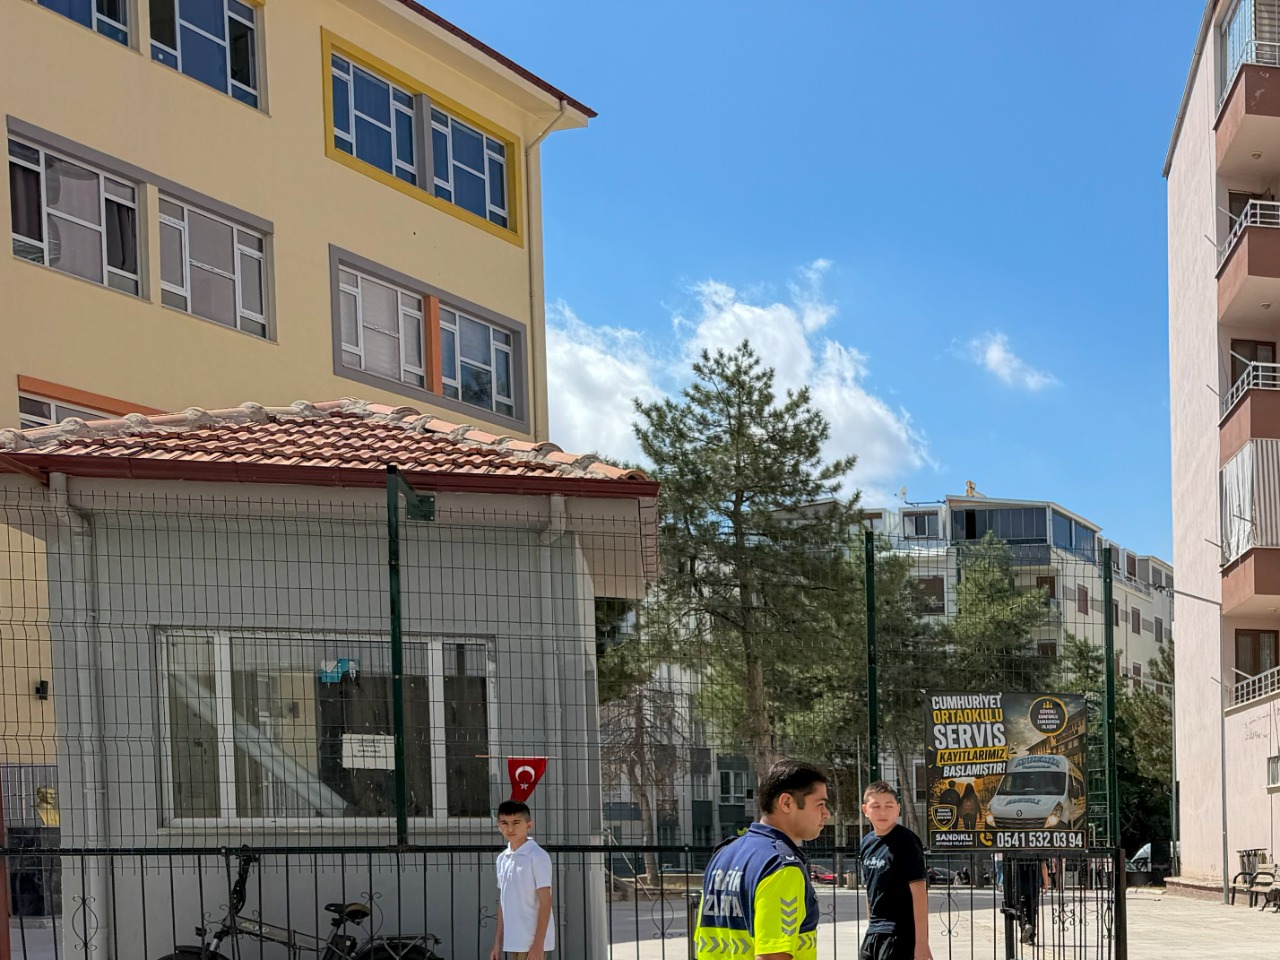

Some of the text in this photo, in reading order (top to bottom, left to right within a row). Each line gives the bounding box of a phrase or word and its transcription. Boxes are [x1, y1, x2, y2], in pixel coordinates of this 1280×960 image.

[931, 693, 1002, 710] CUMHURİYET
[932, 708, 1004, 724] ORTAOKULU
[933, 720, 1007, 750] SERVİS
[939, 748, 1006, 763] KAYITLARIMIZ
[942, 762, 1006, 778] BAŞLAMIŞTIR!
[996, 832, 1026, 848] 0541
[1028, 832, 1051, 848] 532
[1053, 831, 1067, 848] 03
[1069, 832, 1083, 848] 94
